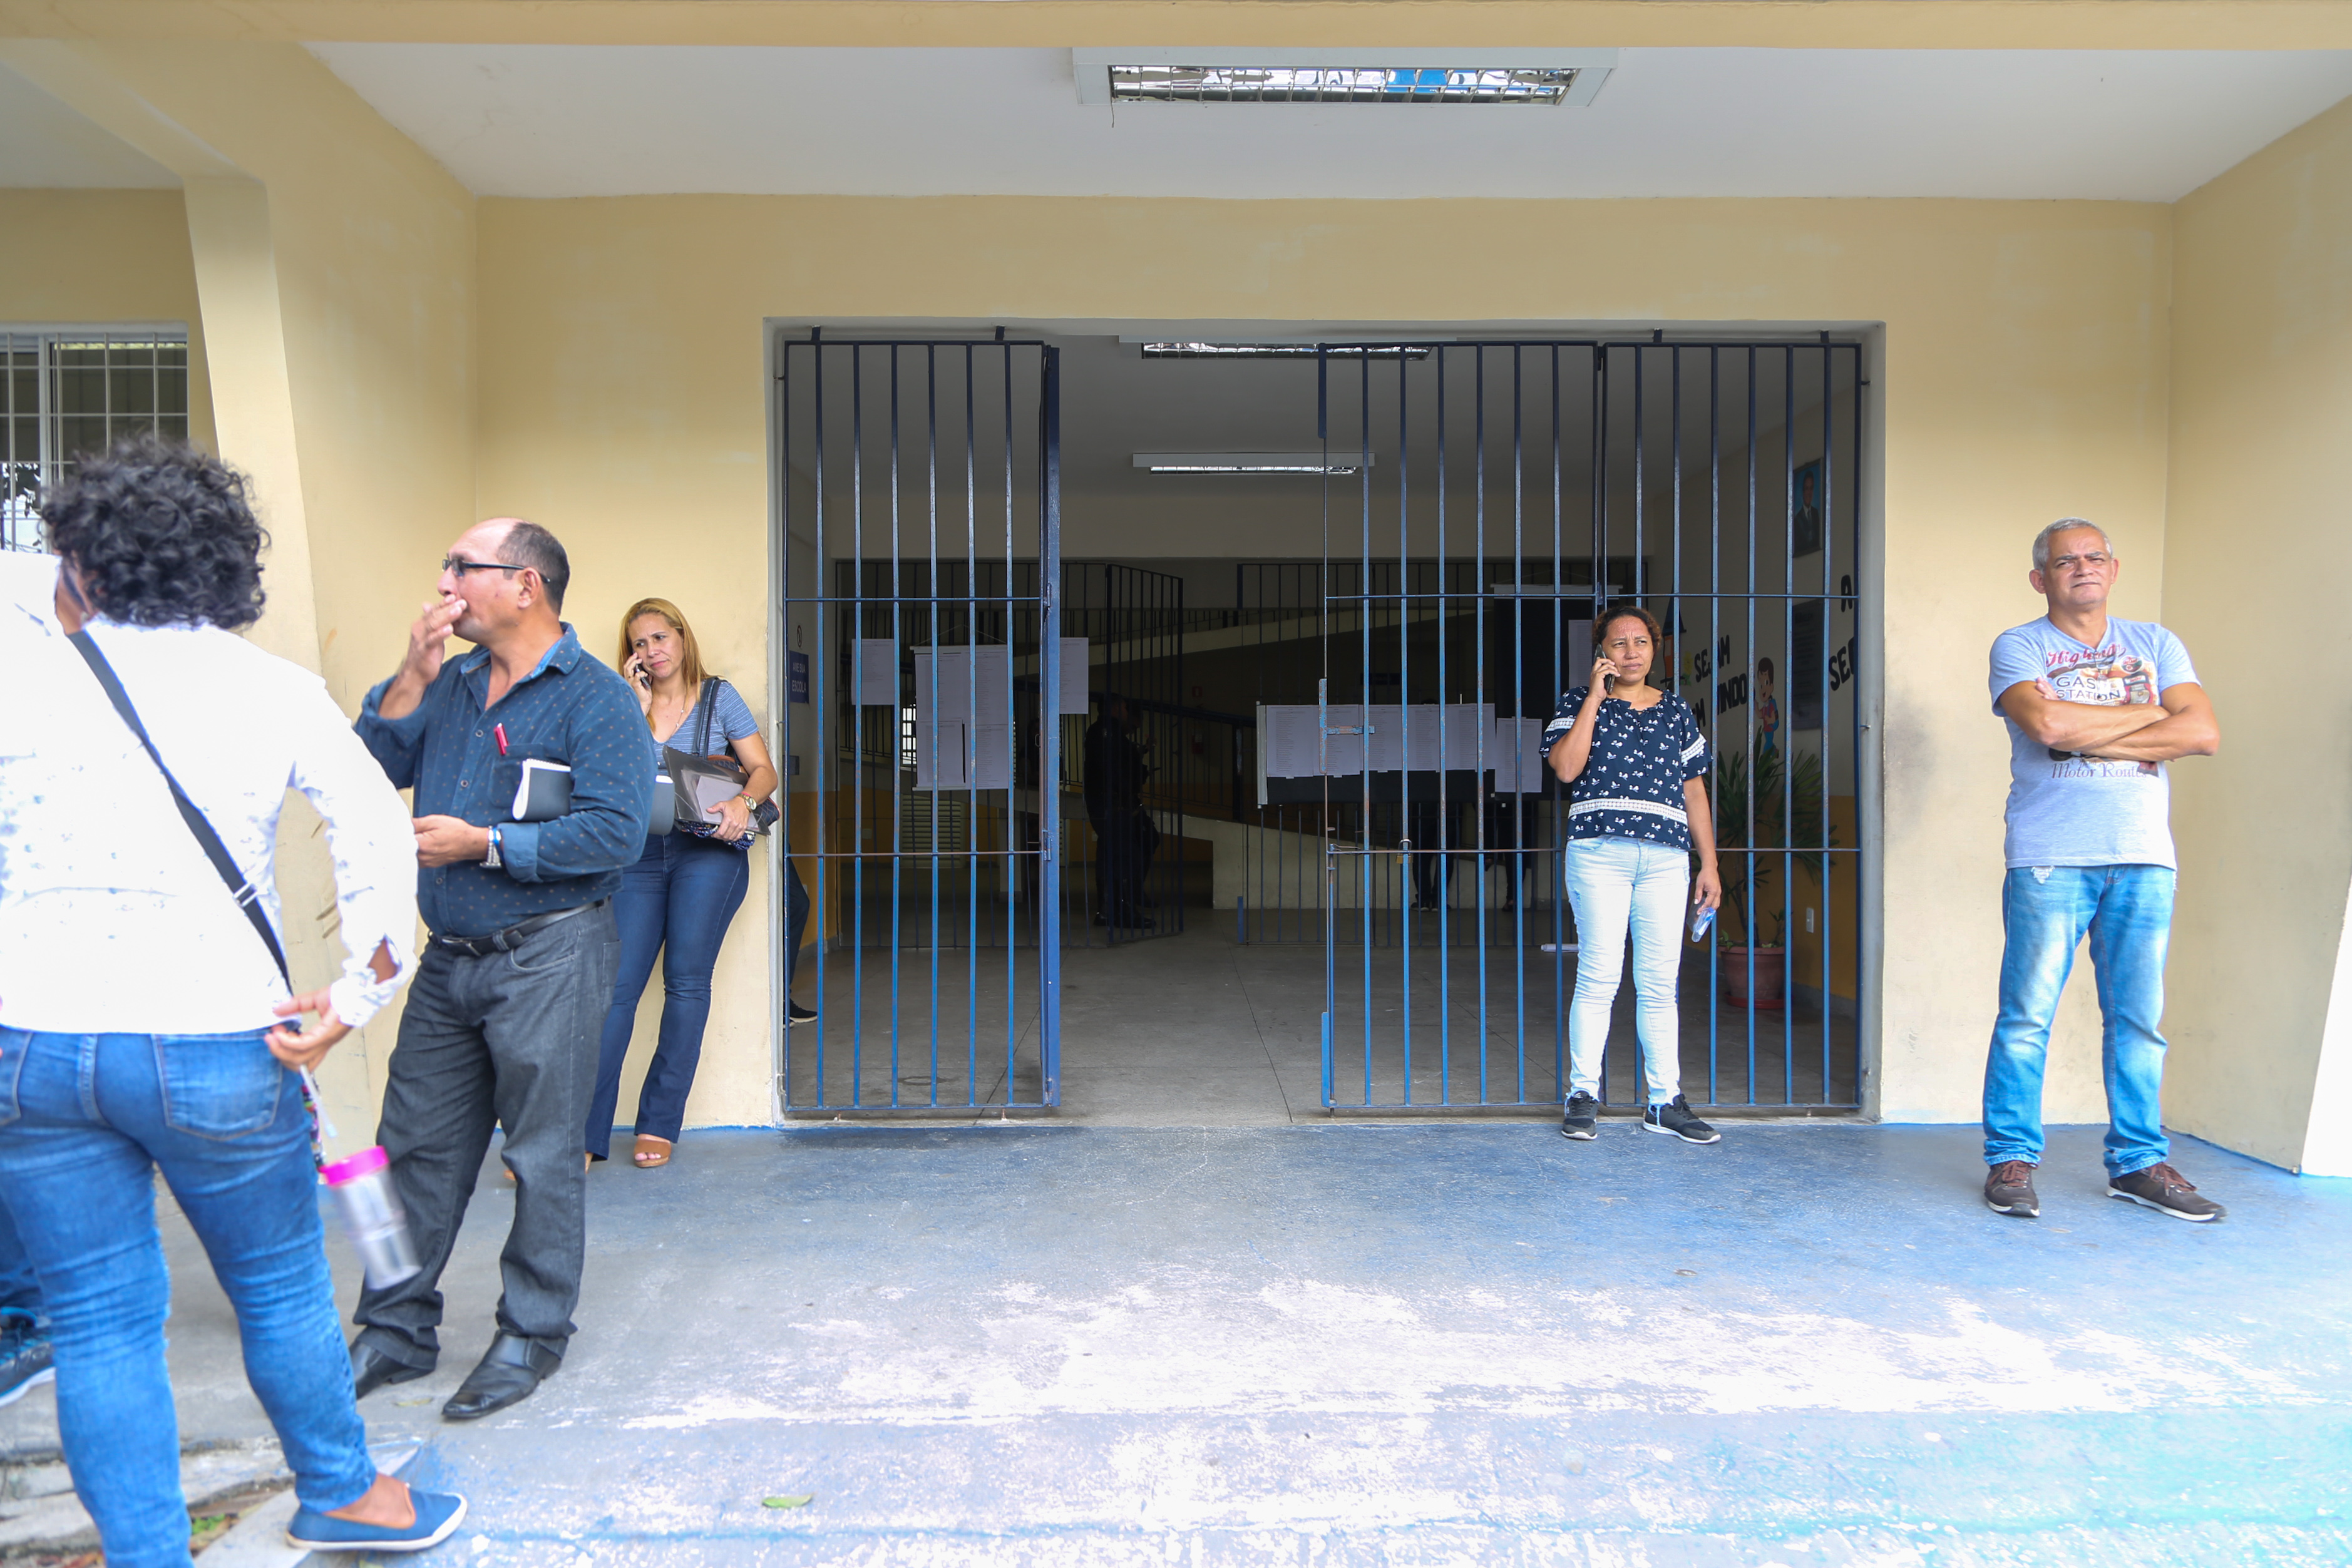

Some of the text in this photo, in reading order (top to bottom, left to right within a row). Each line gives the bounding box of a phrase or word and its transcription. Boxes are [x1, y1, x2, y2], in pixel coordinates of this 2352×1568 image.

[792, 680, 807, 693] ESCOLA
[2056, 676, 2096, 689] GAS
[2056, 689, 2121, 702] STATION
[2052, 762, 2097, 779] Motor
